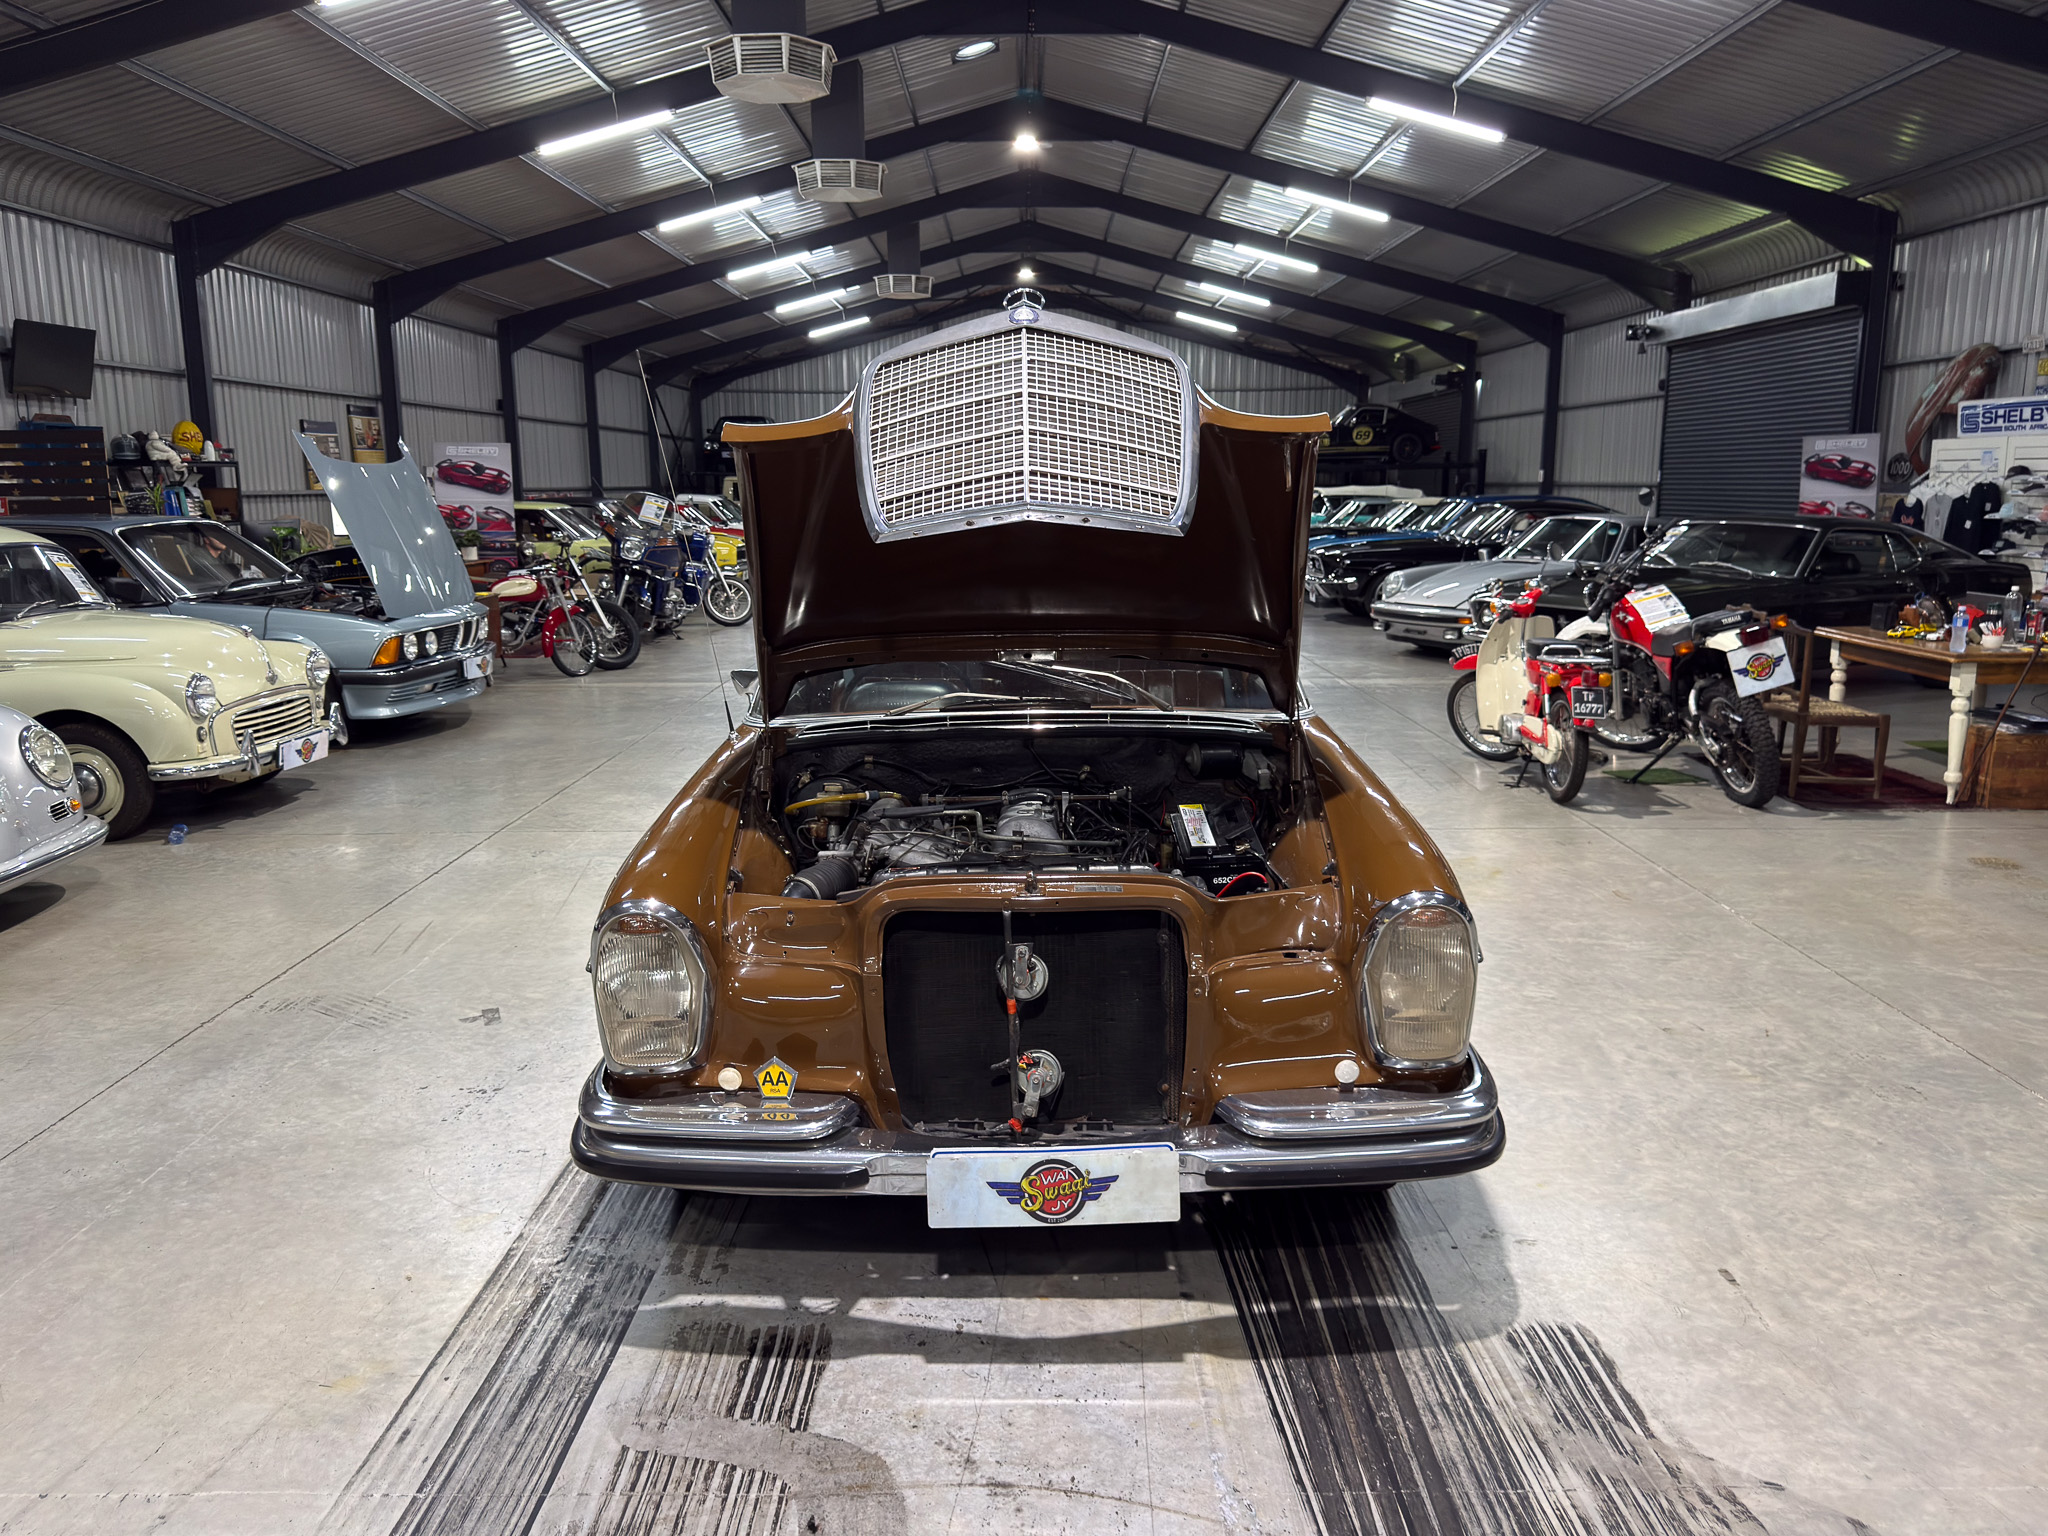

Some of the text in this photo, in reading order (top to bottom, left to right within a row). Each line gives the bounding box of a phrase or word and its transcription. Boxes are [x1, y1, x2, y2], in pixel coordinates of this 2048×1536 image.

[1981, 407, 2048, 425] SHELB
[2003, 423, 2048, 432] SOUTH AFRIC
[1355, 430, 1371, 441] 69
[1889, 461, 1911, 475] 1000
[1616, 611, 1634, 624] XT
[1721, 614, 1741, 625] YAMAHA
[1582, 691, 1594, 701] TP
[1574, 702, 1603, 714] 16777
[762, 1071, 788, 1086] AA
[1040, 1166, 1076, 1185] WAT
[1020, 1169, 1092, 1212] Swaai
[1051, 1199, 1071, 1211] JY
